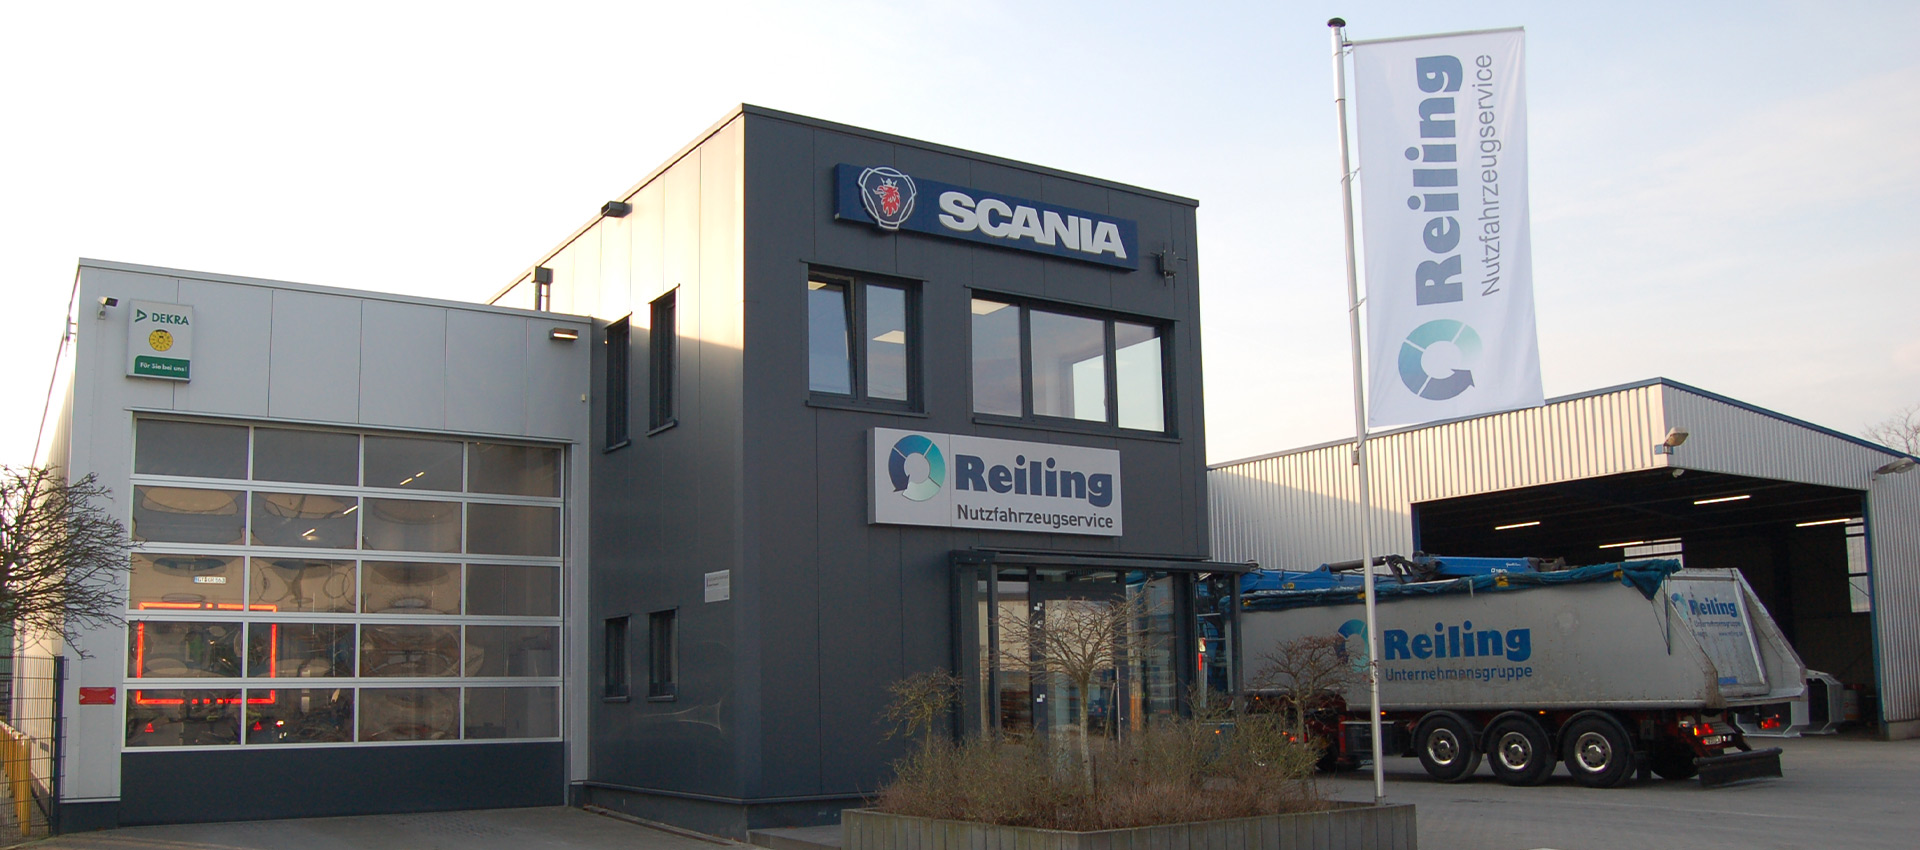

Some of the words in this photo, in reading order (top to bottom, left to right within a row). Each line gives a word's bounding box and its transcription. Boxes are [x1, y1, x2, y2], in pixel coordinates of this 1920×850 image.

[1404, 54, 1464, 307] Reiling
[1472, 53, 1502, 297] Nutzfahrzeugservice
[938, 191, 1128, 260] SCANIA
[151, 312, 190, 326] DEKRA
[140, 361, 151, 369] Für
[955, 454, 1113, 508] Reiling
[957, 504, 1114, 530] Nutzfahrzeugservice
[1688, 597, 1738, 618] Reiling
[1383, 620, 1532, 662] Reiling
[1385, 665, 1533, 682] Unternehmensgruppe
